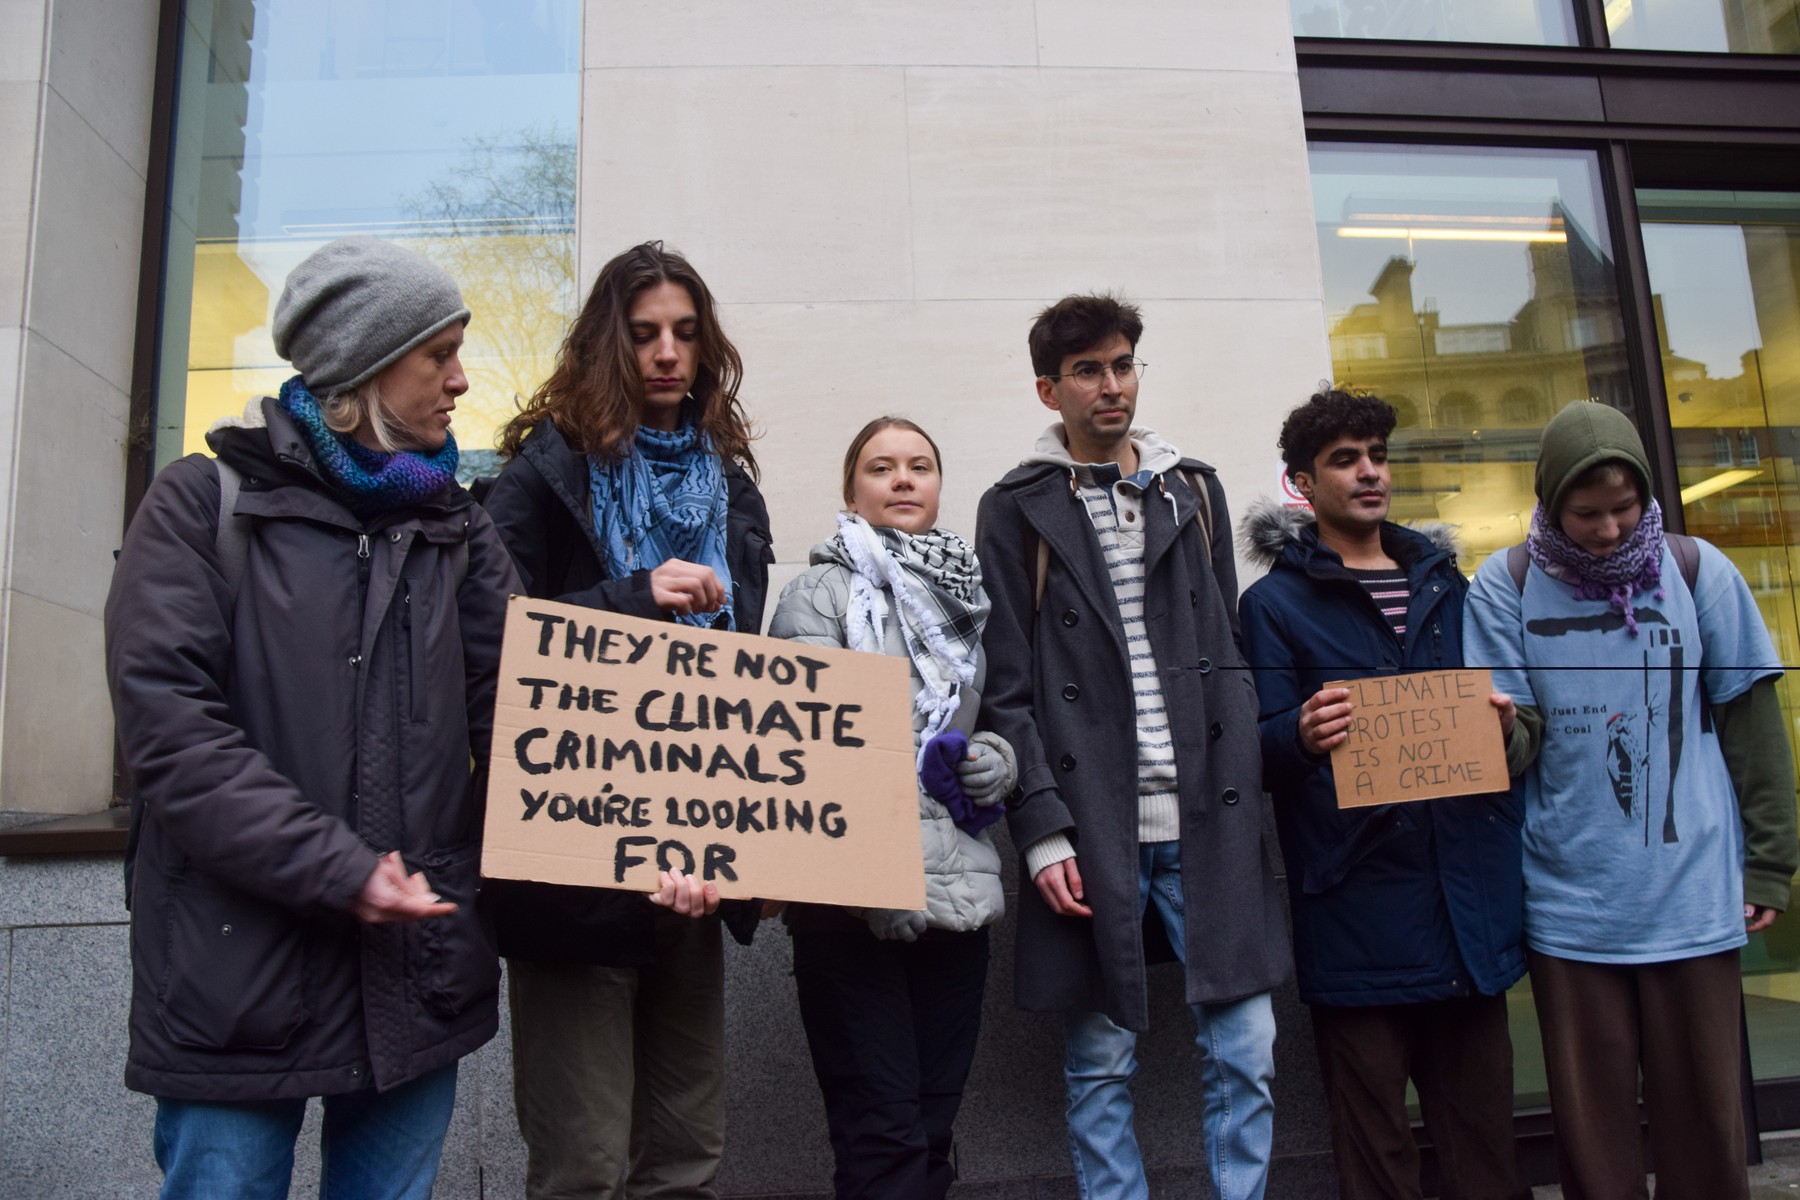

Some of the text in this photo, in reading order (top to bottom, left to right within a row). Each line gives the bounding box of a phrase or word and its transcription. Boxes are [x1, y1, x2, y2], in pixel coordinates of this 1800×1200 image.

[525, 611, 831, 693] THEY'RE NOT
[517, 677, 866, 748] THE CLIMATE
[1345, 705, 1460, 745] PROTEST
[1551, 704, 1607, 716] Just End
[1564, 725, 1591, 735] Coal
[514, 727, 807, 786] CRIMINALS
[1350, 738, 1451, 768] IS NOT
[1355, 761, 1483, 796] A CRIME
[520, 783, 848, 838] YOU'RE LOOKING
[614, 836, 739, 883] FOR
